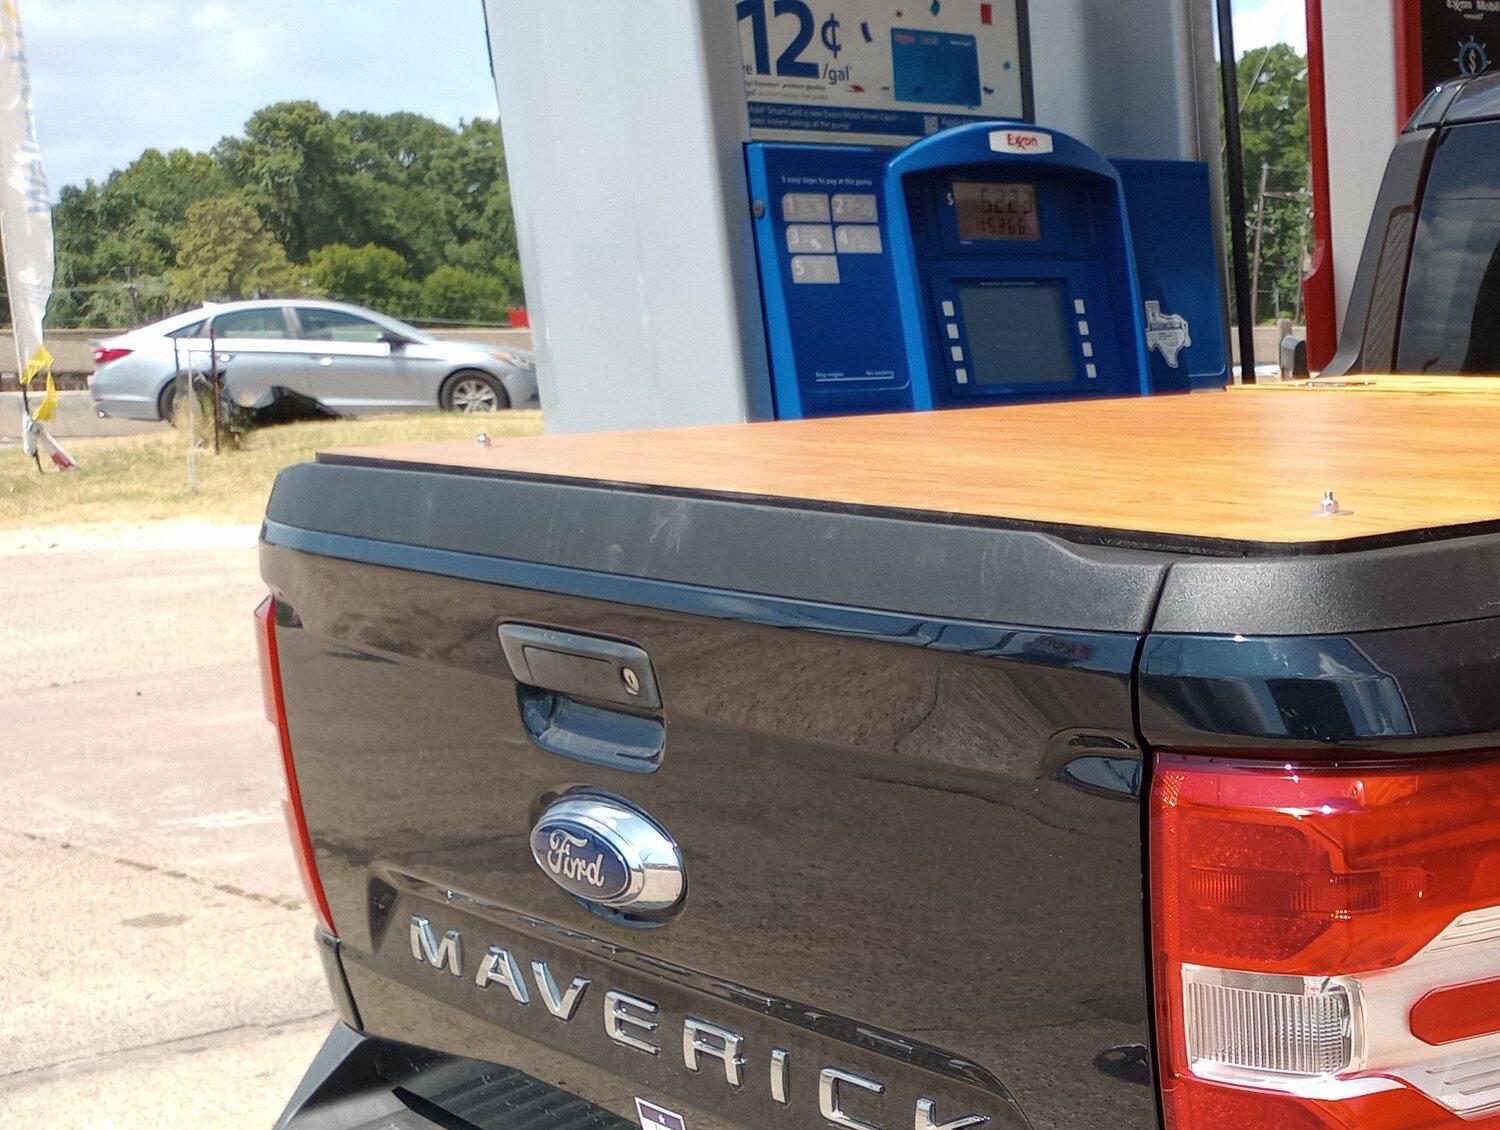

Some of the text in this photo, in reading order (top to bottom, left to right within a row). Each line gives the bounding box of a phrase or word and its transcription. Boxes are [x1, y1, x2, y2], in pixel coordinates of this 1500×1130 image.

[1006, 133, 1038, 150] Exxon
[836, 198, 845, 214] 2
[839, 230, 848, 245] 4
[795, 258, 805, 276] 5
[546, 828, 605, 887] Ford
